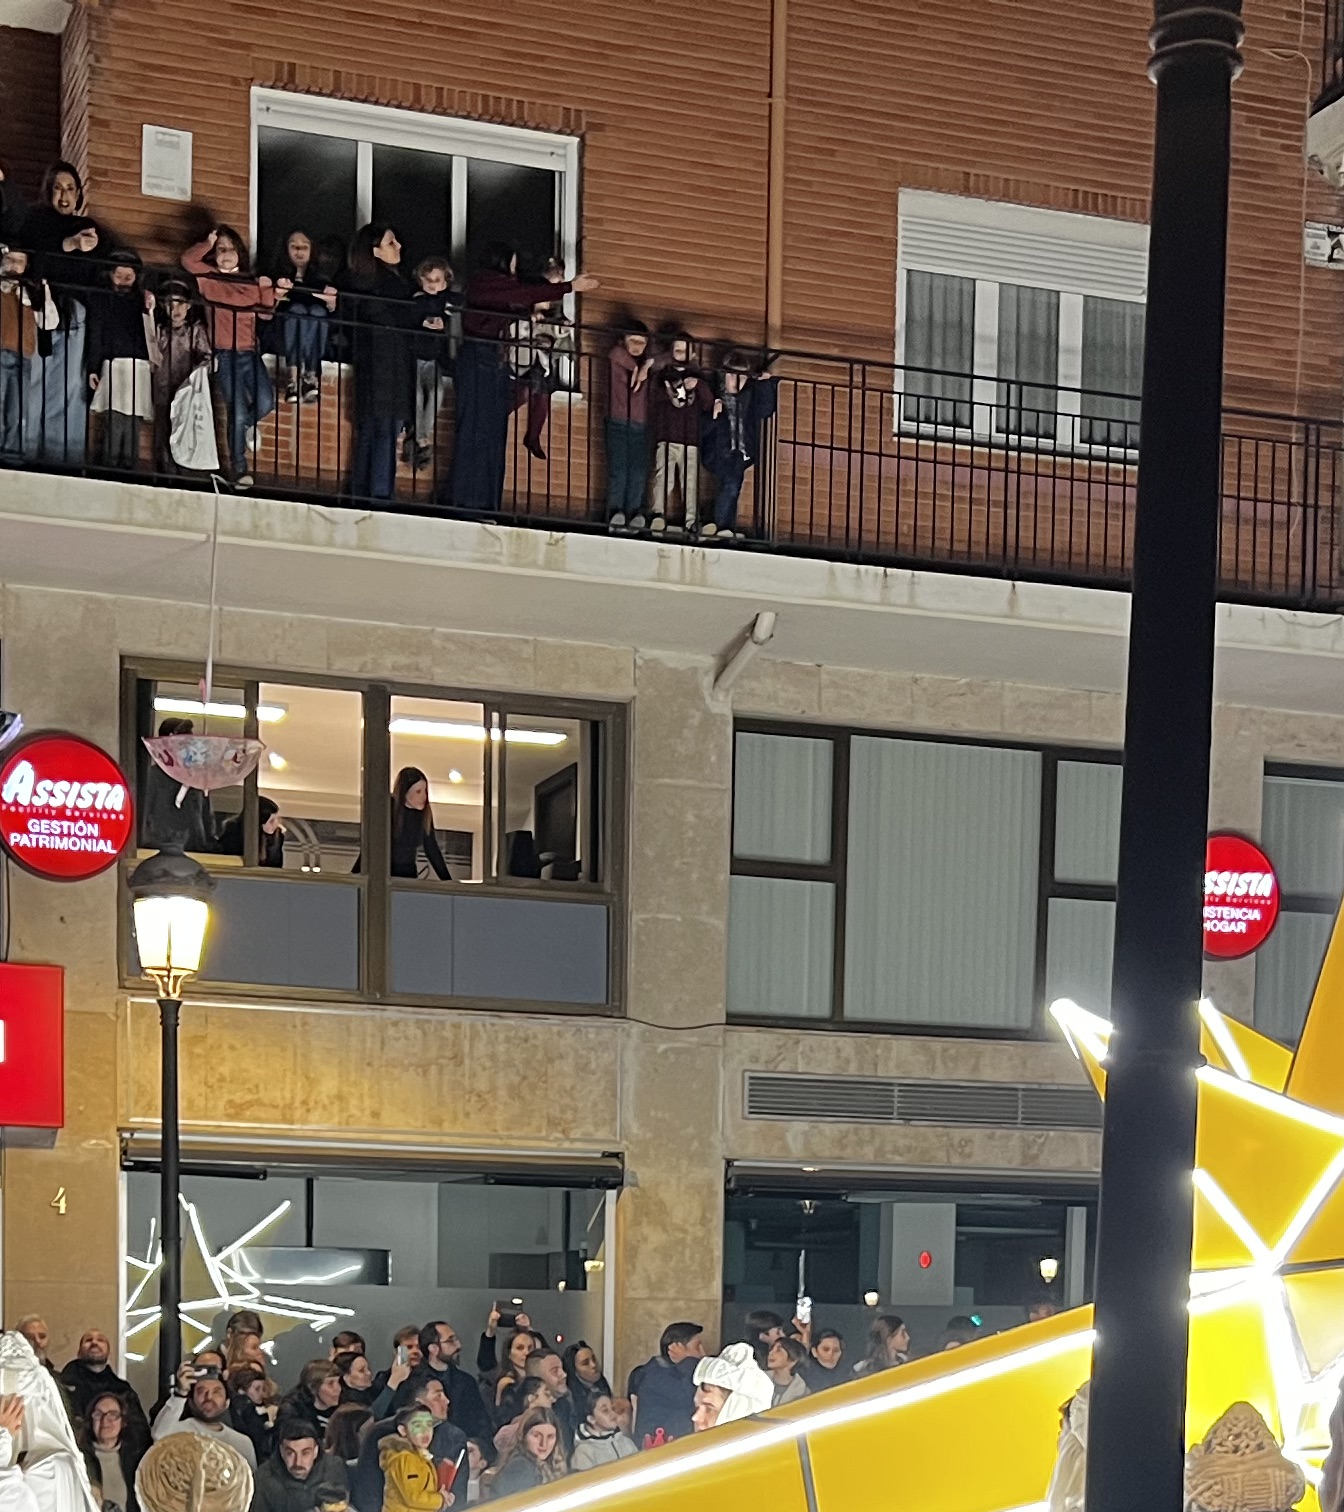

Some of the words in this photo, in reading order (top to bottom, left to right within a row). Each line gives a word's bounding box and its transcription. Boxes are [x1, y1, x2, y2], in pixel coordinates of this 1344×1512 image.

[1, 760, 125, 811] ASSISTA
[27, 818, 99, 837] GESTIÓN
[10, 832, 118, 855] PATRIMONIAL
[1203, 919, 1247, 934] HOGAR
[50, 1187, 67, 1214] 4
